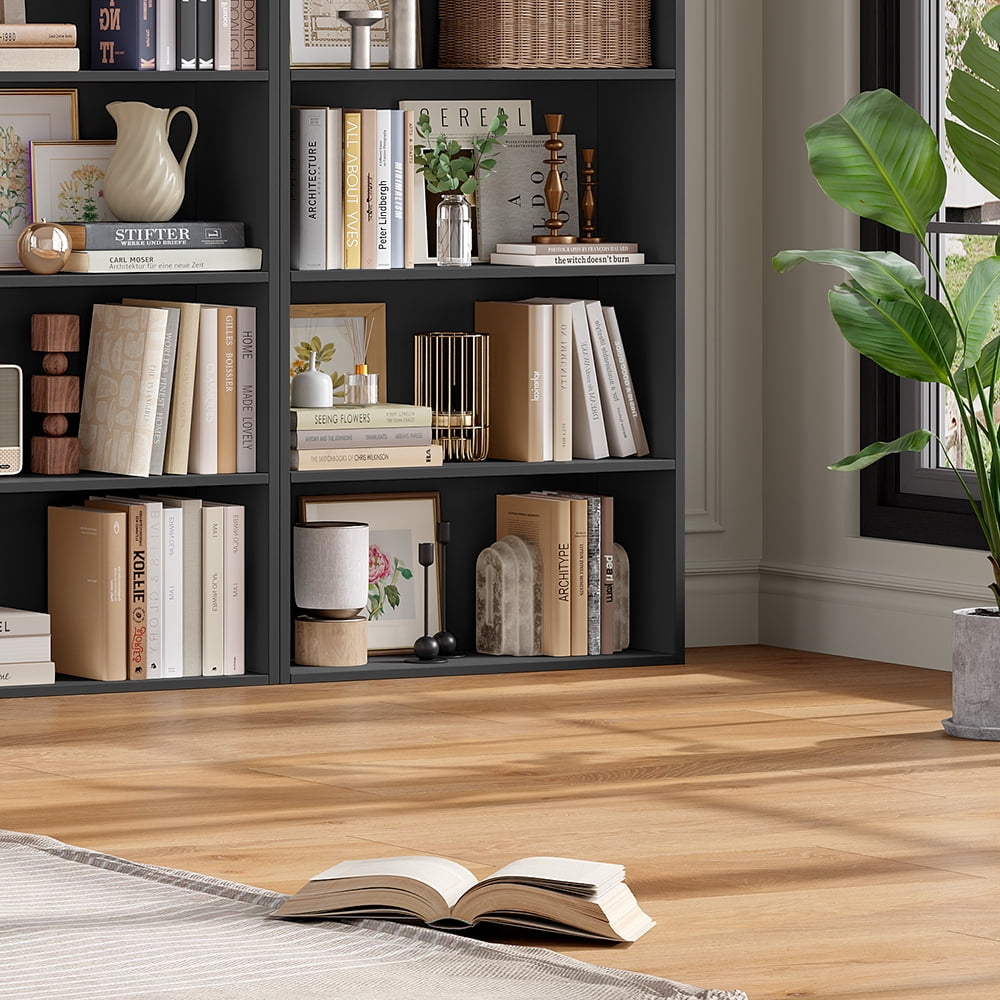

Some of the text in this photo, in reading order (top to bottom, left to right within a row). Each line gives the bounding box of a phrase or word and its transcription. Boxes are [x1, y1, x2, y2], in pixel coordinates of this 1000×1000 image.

[308, 141, 317, 219] ARCHITECTURE
[347, 121, 359, 247] ALL ABOUT YVES
[394, 162, 402, 219] MINIMALISM
[115, 228, 191, 241] STIFTER
[378, 180, 389, 250] Peter Lindbergh
[242, 331, 253, 450] HOME MADE LOVELY
[314, 413, 370, 424] SEEING FLOWERS
[559, 544, 569, 602] ARCHITYPE
[604, 555, 613, 581] pearl
